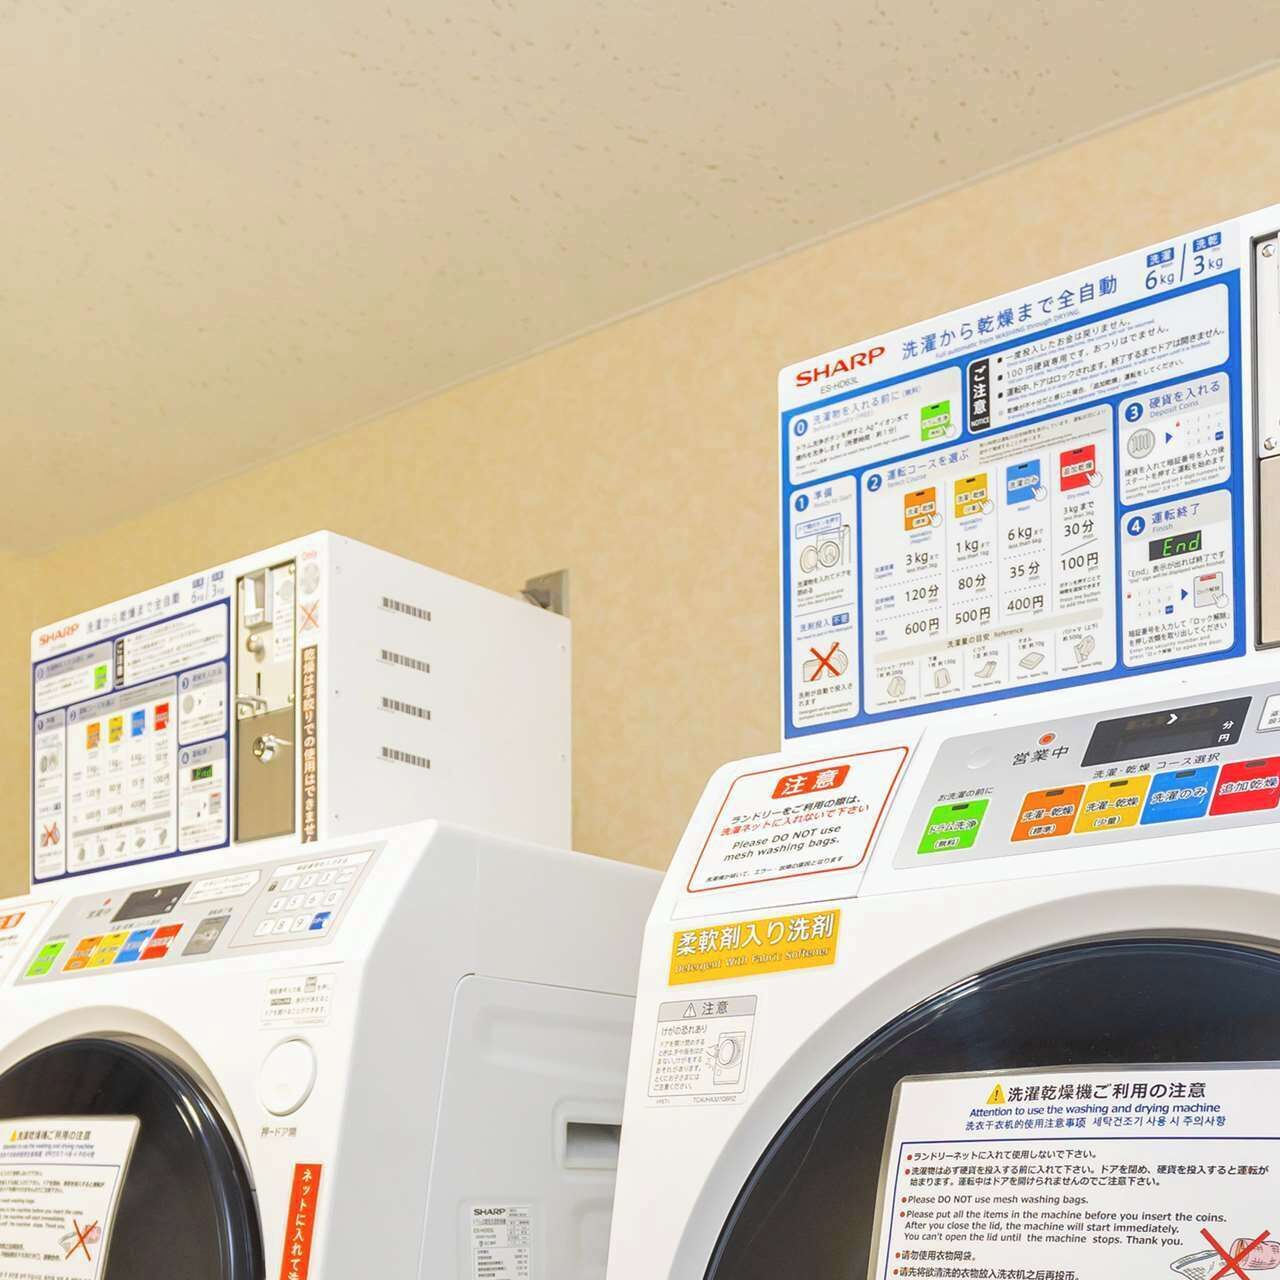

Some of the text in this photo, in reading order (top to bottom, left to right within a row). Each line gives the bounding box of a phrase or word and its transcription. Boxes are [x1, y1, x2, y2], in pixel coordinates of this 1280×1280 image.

[901, 274, 1118, 361] 洗濯から乾燥まで全自動
[795, 346, 886, 387] SHARP
[1149, 381, 1220, 409] 硬貨を入れる
[1151, 503, 1201, 526] 運転終了
[1064, 519, 1095, 537] 30分
[1162, 532, 1201, 557] End
[1009, 561, 1040, 578] 35分
[1061, 552, 1099, 571] 100円
[957, 573, 987, 591] 80分
[905, 584, 939, 602] 120分
[1007, 595, 1044, 612] 400円
[955, 606, 991, 624] 500円
[38, 623, 80, 646] SHARP
[904, 617, 940, 636] 600円
[1222, 719, 1235, 731] 分
[1218, 733, 1230, 743] 円
[1012, 744, 1070, 766] 営業中
[782, 768, 838, 795] 注意
[1219, 777, 1279, 794] 追加乾燥
[1152, 788, 1208, 804] 洗濯のみ
[720, 804, 870, 836] 洗濯ネットに入れないで下さい
[732, 825, 841, 850] Please DO NOT use
[723, 836, 840, 862] mesh washing bags.
[676, 911, 835, 957] 柔軟剤入り洗剤
[1007, 1081, 1207, 1102] 洗濯乾燥機ご利用の注意
[970, 1103, 1221, 1118] Attention to use the washing and drying machine
[965, 1117, 1087, 1131] 洗衣干衣机的使用注意事项
[1093, 1115, 1227, 1128] 세탁건조기 사용 시 주의사항
[913, 1149, 1097, 1162] ランドリーネットに入れて使用しないで下さい。
[908, 1195, 1089, 1206] Please DO NOT use mesh washing bags.
[906, 1210, 1227, 1223] Please put all the items in the machine before you insert the coins.
[901, 1249, 976, 1262] 请勿使用衣物网袋。
